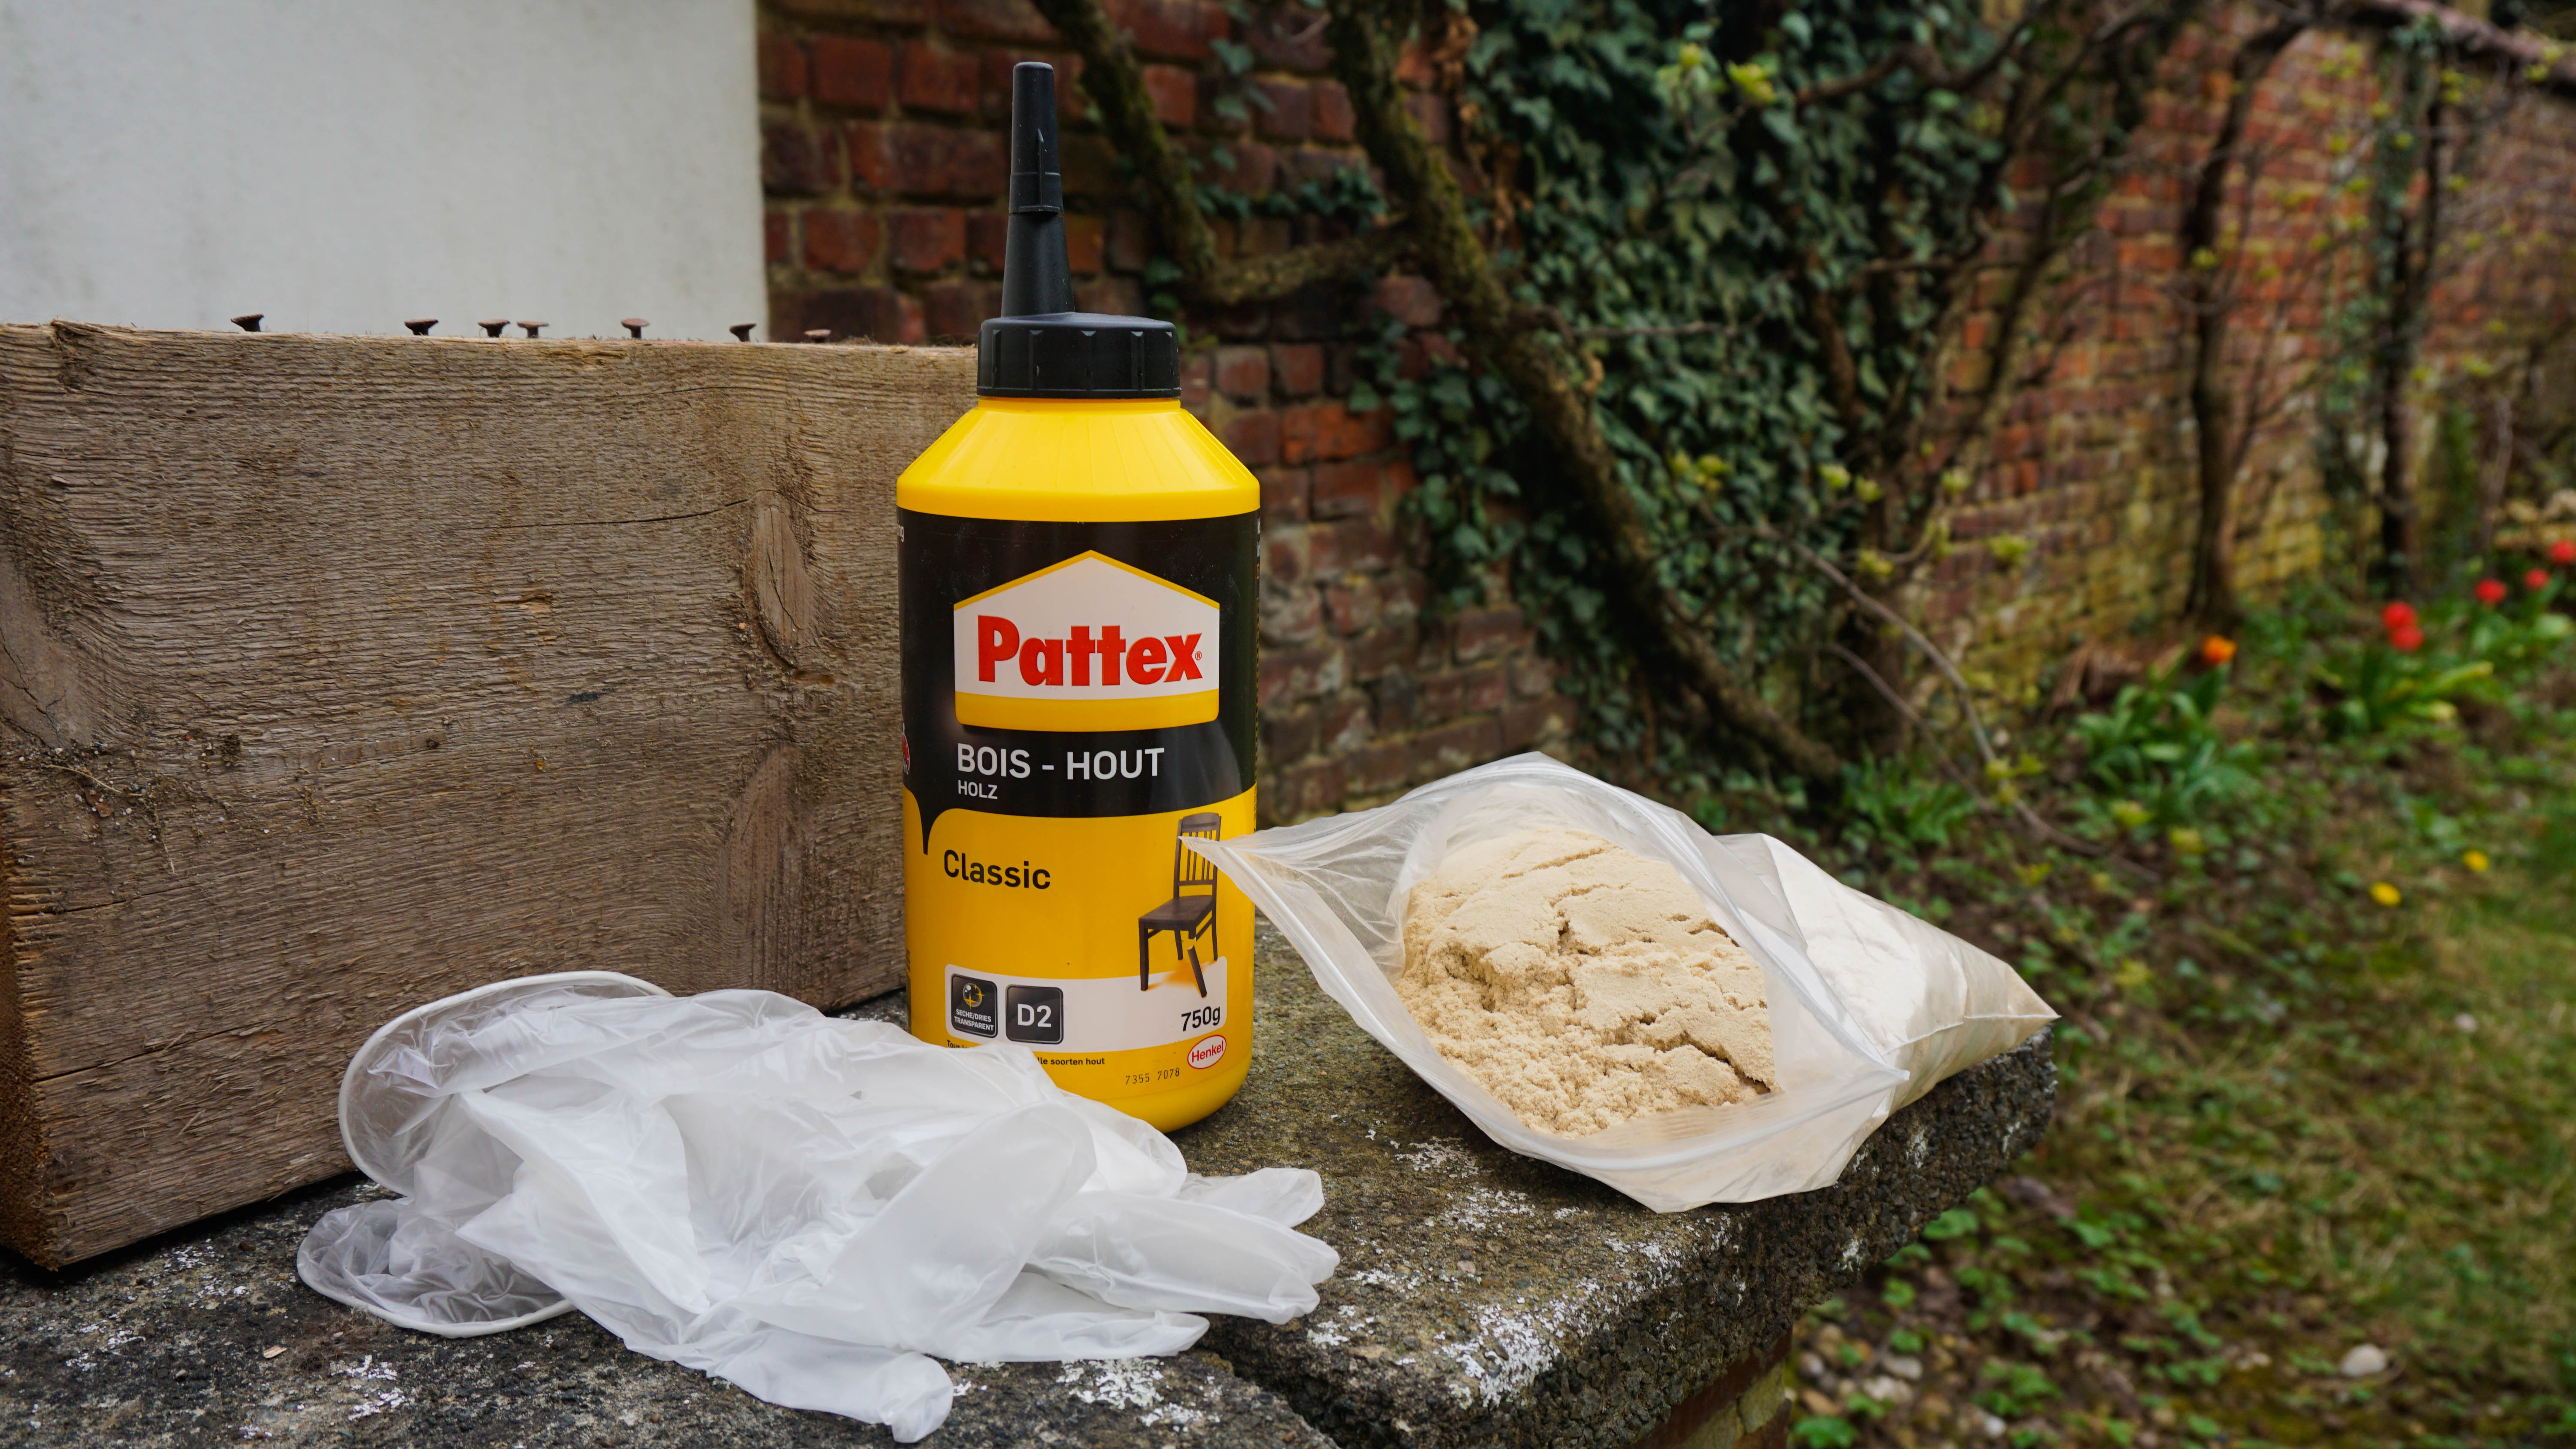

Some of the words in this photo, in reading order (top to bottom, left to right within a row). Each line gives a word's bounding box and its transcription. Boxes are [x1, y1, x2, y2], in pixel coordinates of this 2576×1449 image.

[958, 743, 1031, 779] BOIS
[1067, 747, 1165, 780] HOUT
[958, 780, 998, 800] HOLZ
[944, 849, 1051, 890] Classic
[954, 1016, 994, 1031] TRANSPARENT
[956, 1009, 992, 1023] SECHE/DRIES
[1017, 1003, 1051, 1028] D2
[1181, 1006, 1221, 1032] 750g
[1191, 1040, 1224, 1063] Henkel
[1125, 1073, 1150, 1085] 7355
[1157, 1067, 1180, 1081] 7078
